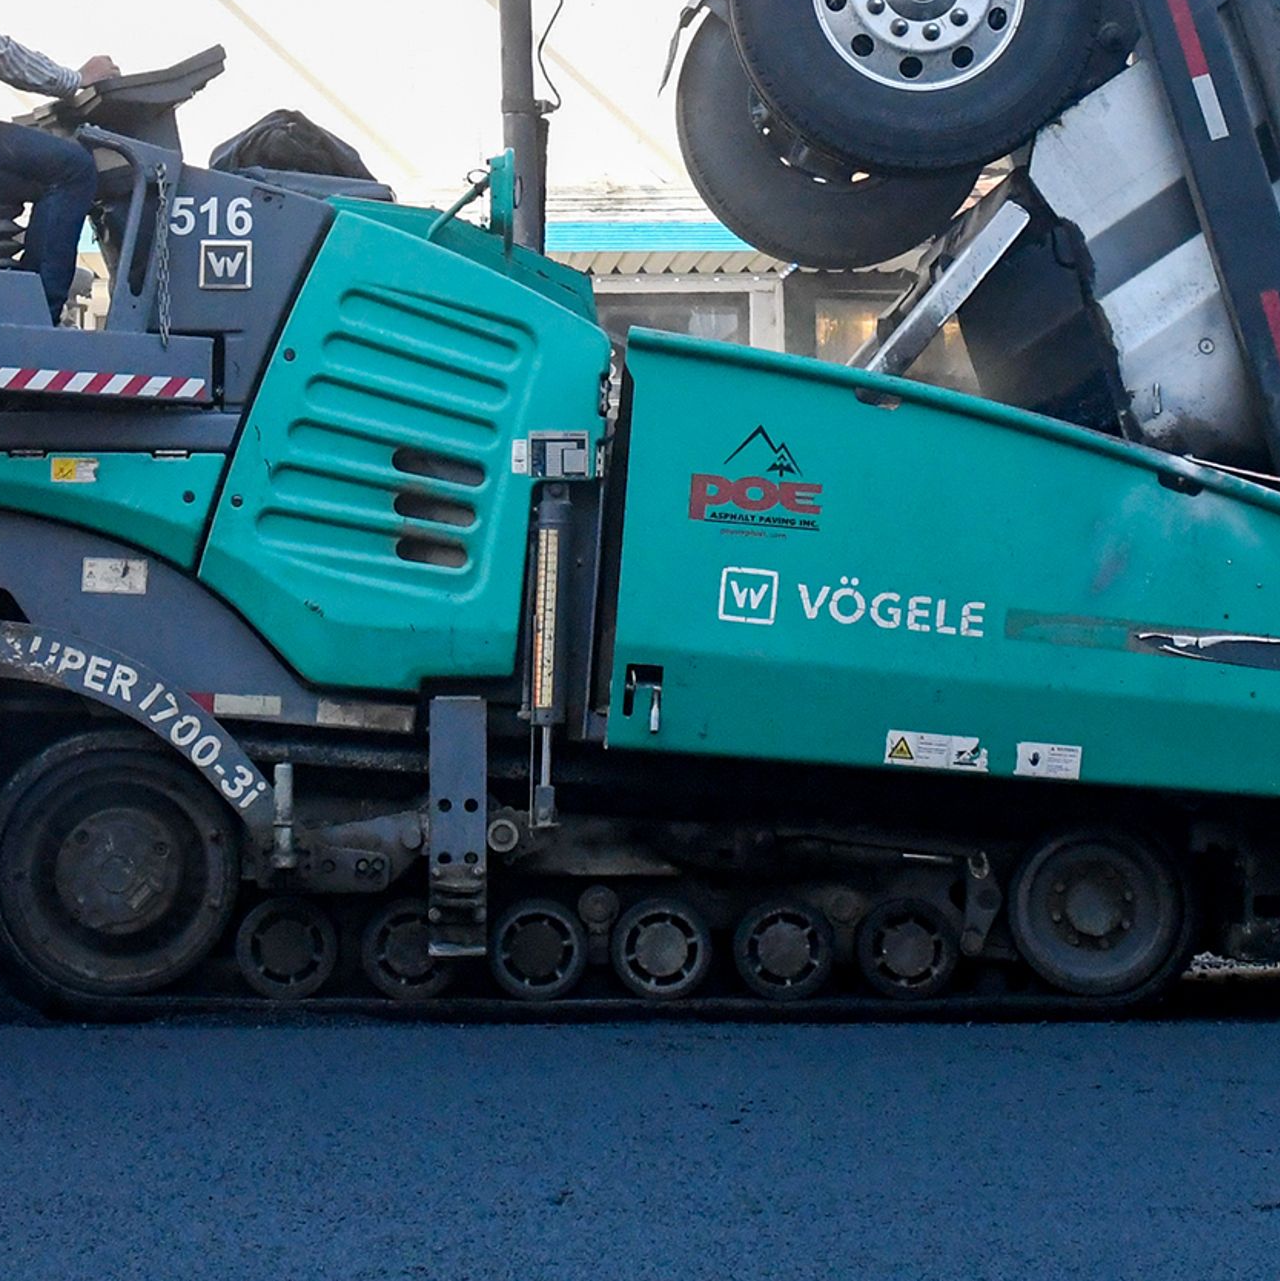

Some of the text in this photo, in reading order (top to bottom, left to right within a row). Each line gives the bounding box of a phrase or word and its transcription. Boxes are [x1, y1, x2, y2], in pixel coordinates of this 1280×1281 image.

[169, 197, 253, 236] 516
[688, 473, 823, 520] POE
[710, 511, 819, 528] ASPHALT PAVING INC.
[797, 576, 986, 638] VÖGELE
[138, 682, 267, 809] 1700-3i
